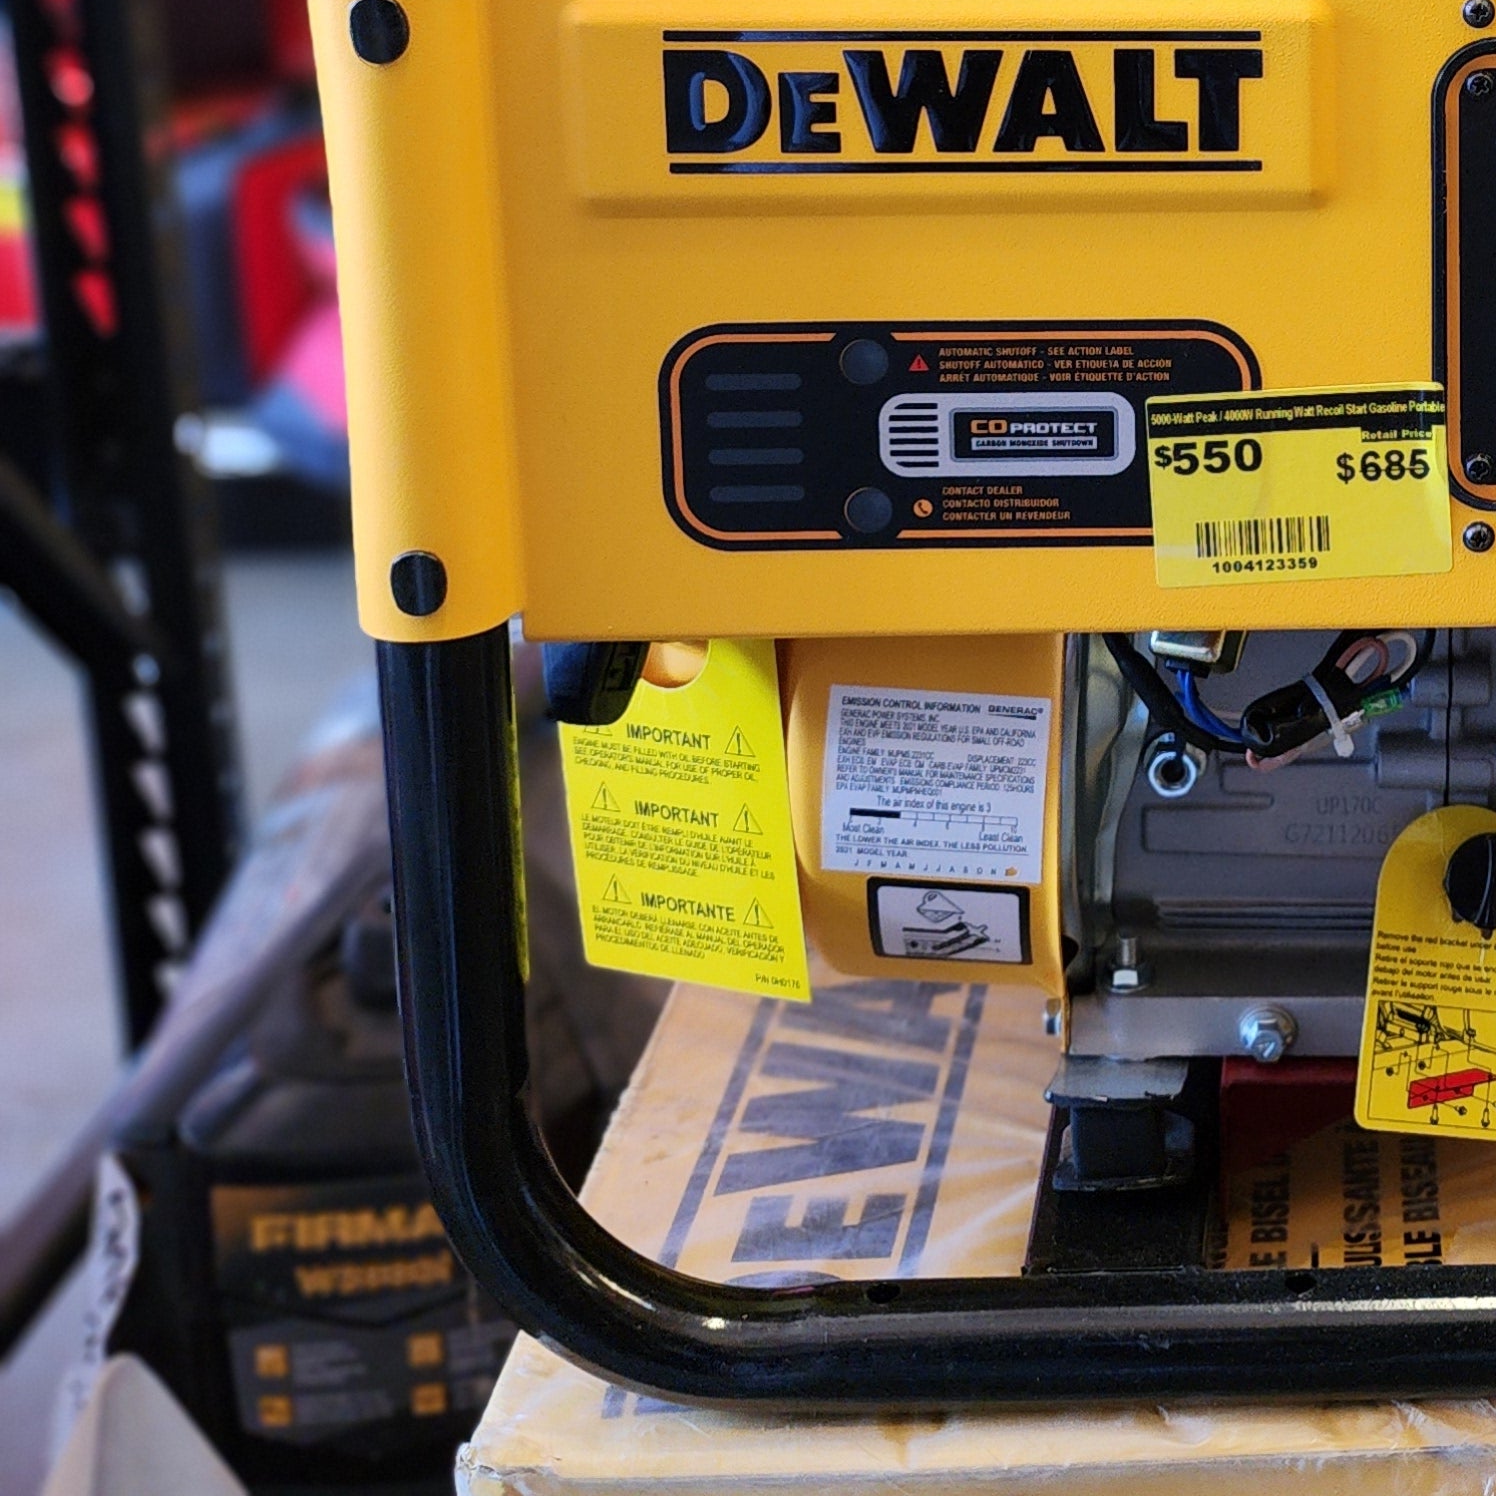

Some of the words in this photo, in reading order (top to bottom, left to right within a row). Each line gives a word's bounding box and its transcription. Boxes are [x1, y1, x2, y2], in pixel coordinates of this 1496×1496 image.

[662, 48, 1263, 154] DEWALT
[938, 346, 994, 357] AUTOMATIC
[995, 346, 1037, 356] SHUTOFF
[1047, 346, 1066, 356] SEE
[1068, 346, 1102, 356] ACTION
[1104, 346, 1135, 356] LABEL
[938, 360, 982, 370] SHUTOFF
[1053, 359, 1073, 369] VER
[1075, 359, 1120, 369] ETIQUETA
[1122, 359, 1135, 369] DE
[973, 372, 1040, 383] AUTOMATIQUE
[1049, 372, 1072, 382] VOIR
[1126, 371, 1170, 382] D'ACTION
[1150, 413, 1195, 426] 5000-Watt
[1195, 411, 1218, 423] Peak
[1255, 407, 1294, 422] Running
[1293, 406, 1315, 418] Watt
[1315, 404, 1345, 417] Recoil
[1346, 403, 1367, 415] Start
[1369, 401, 1408, 414] Gasoline
[1408, 400, 1445, 412] Portable
[1361, 429, 1398, 441] Retail
[1401, 428, 1433, 439] Price
[975, 439, 1007, 447] CARBON
[1009, 439, 1049, 447] MONOXIDE
[1052, 438, 1094, 447] SHUTDOWN
[1154, 438, 1263, 476] $550
[1336, 448, 1430, 484] $685
[942, 486, 985, 496] CONTACT
[987, 485, 1023, 495] DEALER
[942, 498, 991, 509] CONTACTO
[993, 498, 1060, 508] DISTRIBUIDOR
[942, 511, 997, 521] CONTACTER
[999, 511, 1013, 521] UN
[1015, 510, 1071, 521] REVENDEUR
[1212, 556, 1318, 574] 1004123359
[841, 696, 883, 708] EMISSION
[882, 698, 922, 711] CONTROL
[924, 701, 982, 714] INFORMATION
[626, 723, 711, 750] IMPORTANT
[634, 800, 719, 828] IMPORTANT
[641, 892, 736, 922] IMPORTANTE
[1377, 930, 1410, 942] Remove
[1411, 934, 1423, 943] the
[1425, 935, 1438, 944] red
[1376, 943, 1402, 953] before
[1402, 946, 1417, 954] use
